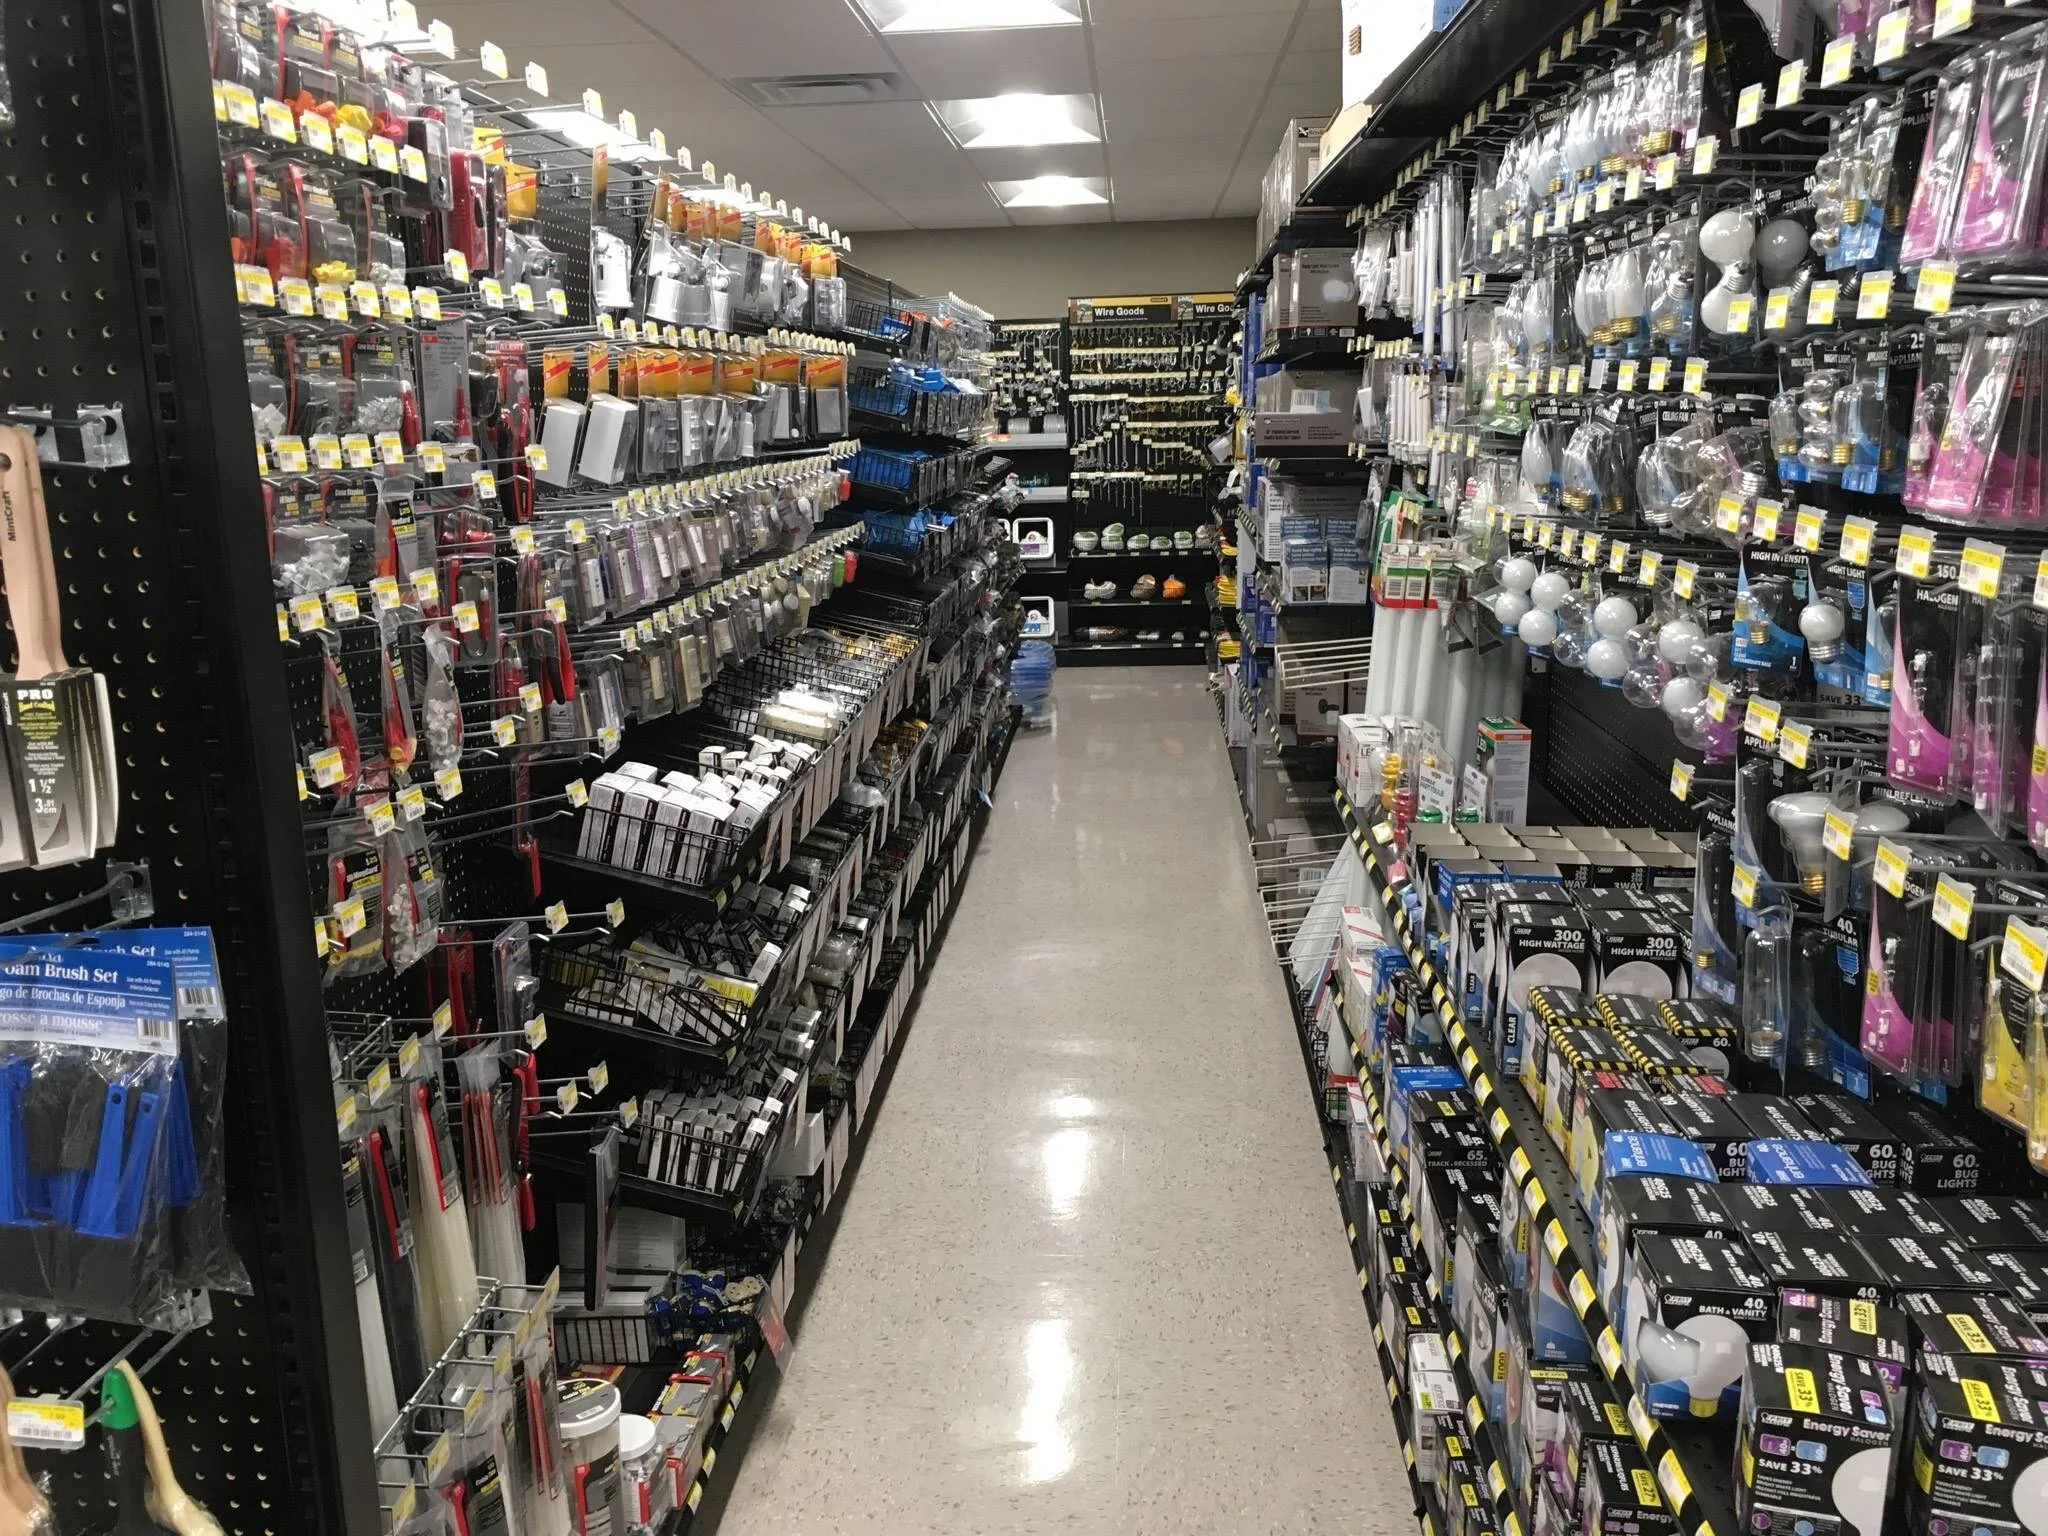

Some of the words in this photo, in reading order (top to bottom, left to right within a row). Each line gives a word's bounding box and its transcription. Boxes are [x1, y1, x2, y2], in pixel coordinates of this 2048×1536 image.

[1095, 308, 1114, 316] Wire
[1116, 307, 1144, 316] Goods
[1196, 304, 1215, 313] Wire
[1889, 352, 1922, 366] APPLIAN
[1678, 412, 1689, 423] FAN
[1751, 551, 1770, 561] HIGH
[1847, 567, 1866, 580] LIGHT
[17, 689, 53, 700] PRO
[1820, 694, 1841, 704] SAVE
[1845, 695, 1862, 706] 33
[1519, 939, 1543, 948] HIGH
[1543, 940, 1585, 950] WATTAGE
[1611, 947, 1635, 956] HIGH
[1636, 948, 1677, 957] WATTAGE
[5, 964, 40, 977] oam
[45, 963, 88, 981] Brush
[93, 968, 118, 983] Set
[15, 986, 28, 999] de
[32, 987, 70, 1002] Brochas
[73, 991, 85, 1003] de
[87, 993, 125, 1010] Esponja
[0, 1011, 36, 1025] rosse
[52, 1015, 102, 1030] mousse
[1507, 1016, 1516, 1044] CLEAR
[1726, 1142, 1747, 1156] 60
[1729, 1158, 1745, 1167] BU
[1872, 1160, 1896, 1170] BUG
[1719, 1167, 1745, 1177] IGHT
[1865, 1169, 1896, 1180] GHTS
[1955, 1169, 1978, 1179] BUG
[1937, 1179, 1977, 1189] LIGHTS
[1699, 1305, 1724, 1316] BATH
[1732, 1306, 1767, 1317] VANITY
[1803, 1418, 1850, 1437] Energy
[1851, 1426, 1891, 1441] Saver
[1985, 1423, 2033, 1442] Energy
[1850, 1437, 1889, 1447] HALOGEN
[1759, 1459, 1787, 1471] SAVE
[1790, 1461, 1823, 1475] 33%
[1938, 1464, 1968, 1478] SAVE
[1970, 1467, 2004, 1482] 33%
[1637, 1510, 1671, 1523] Energy
